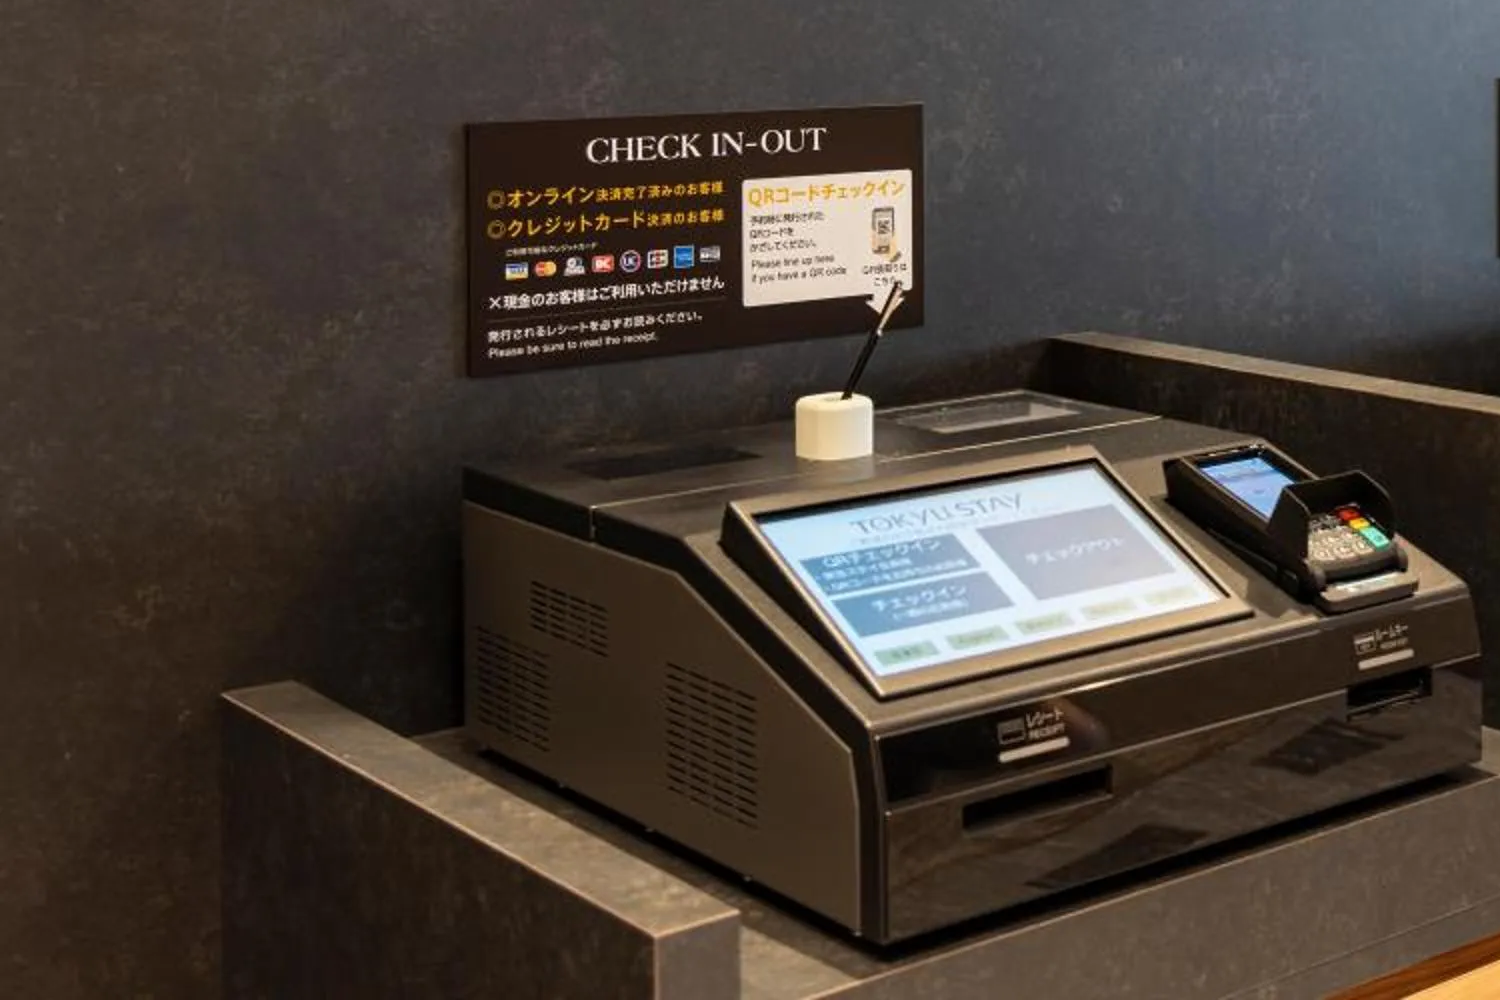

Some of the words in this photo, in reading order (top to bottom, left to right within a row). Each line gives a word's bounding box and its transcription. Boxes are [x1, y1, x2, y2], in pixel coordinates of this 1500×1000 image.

[586, 131, 702, 164] CHECK
[711, 127, 827, 158] IN-OUT
[748, 180, 904, 207] QRコードチェックイン
[850, 503, 951, 535] TOKYU
[954, 493, 1023, 517] STAY
[1026, 707, 1064, 728] レシート
